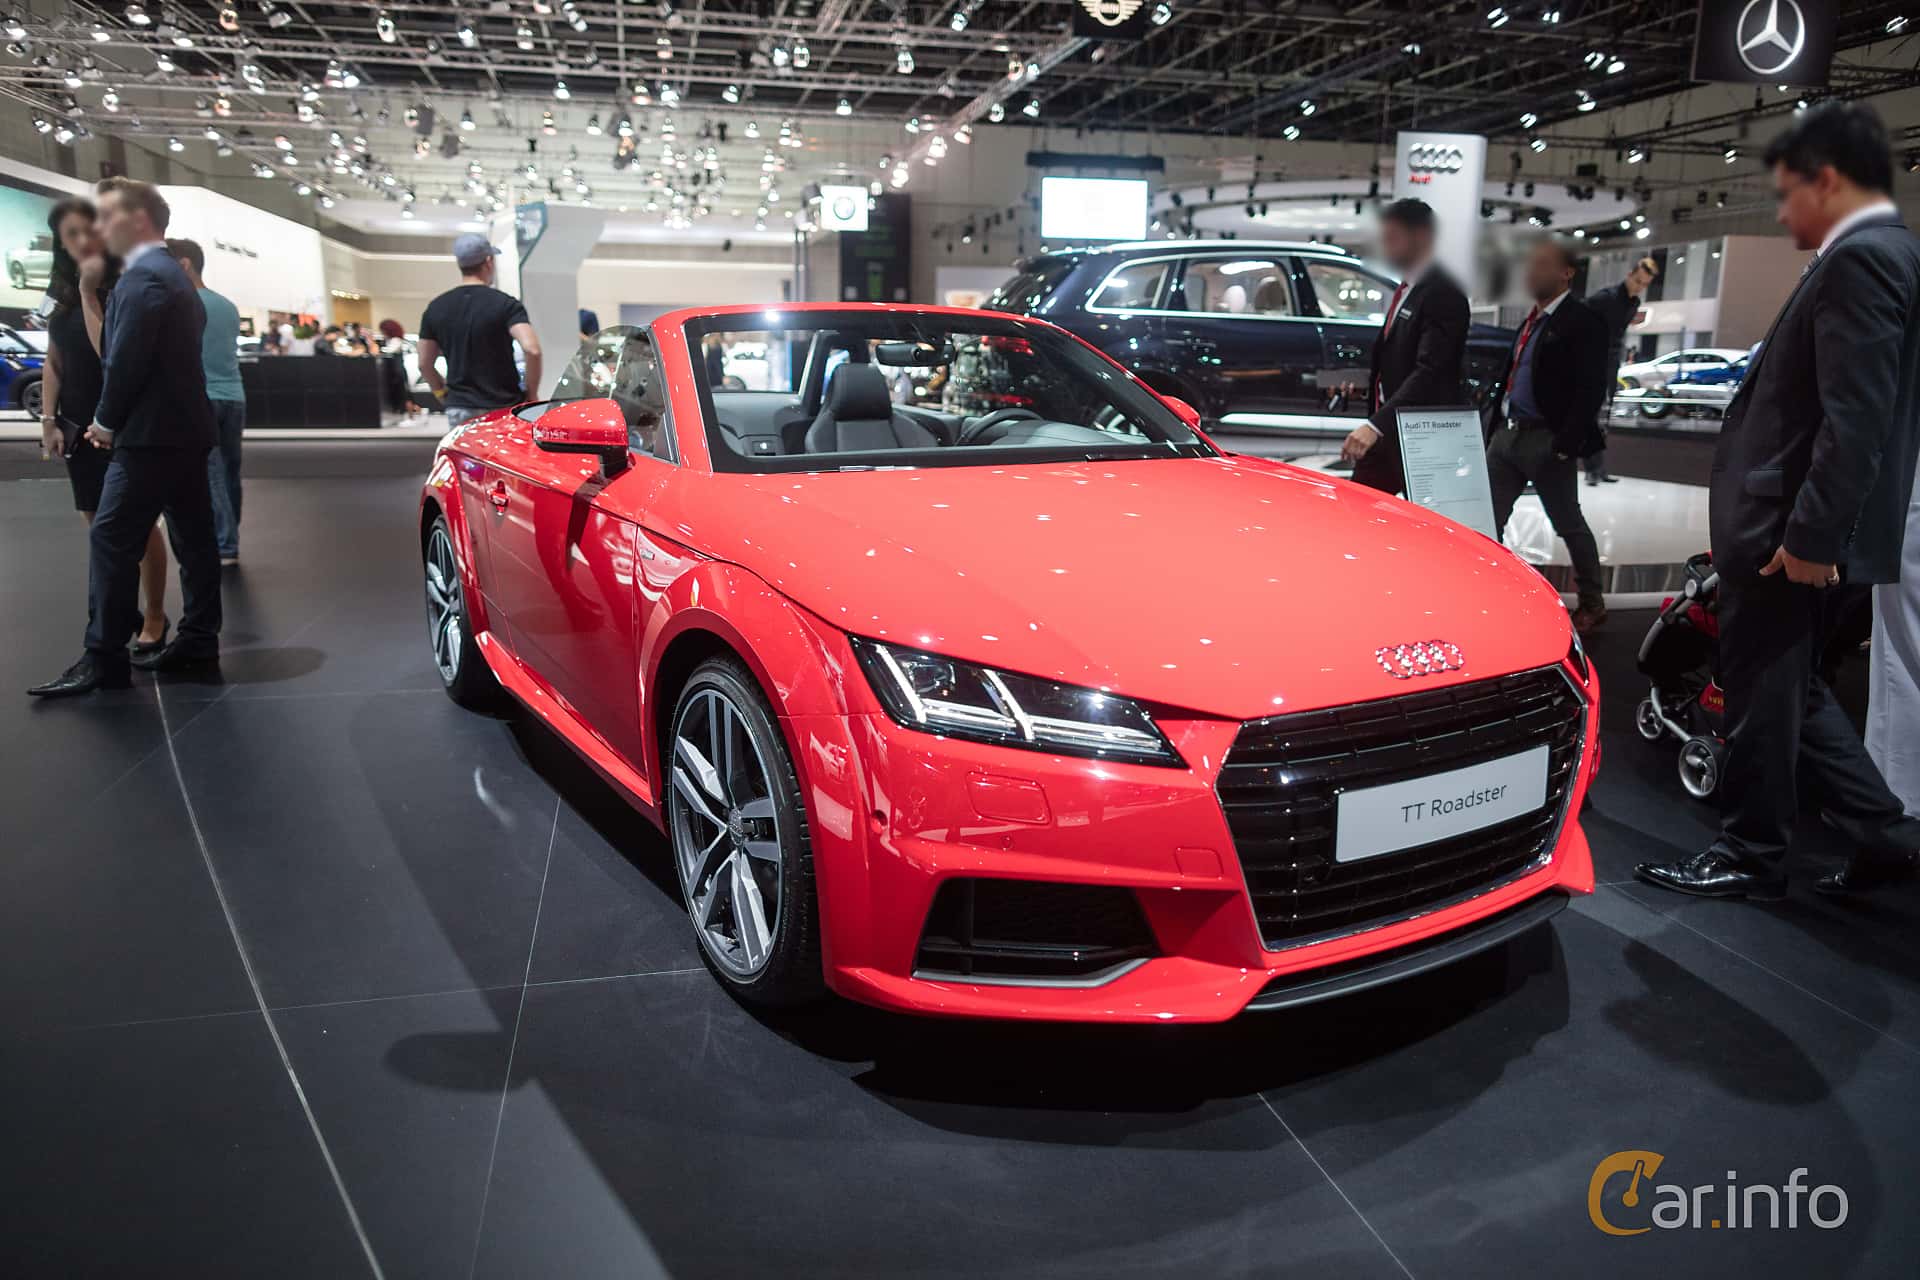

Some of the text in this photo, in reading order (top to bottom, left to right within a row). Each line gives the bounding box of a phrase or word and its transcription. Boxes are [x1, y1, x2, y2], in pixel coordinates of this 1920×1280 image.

[1408, 175, 1431, 185] Audi
[1405, 421, 1462, 429] Audi TT Roadster
[1400, 784, 1508, 823] TT Roadster
